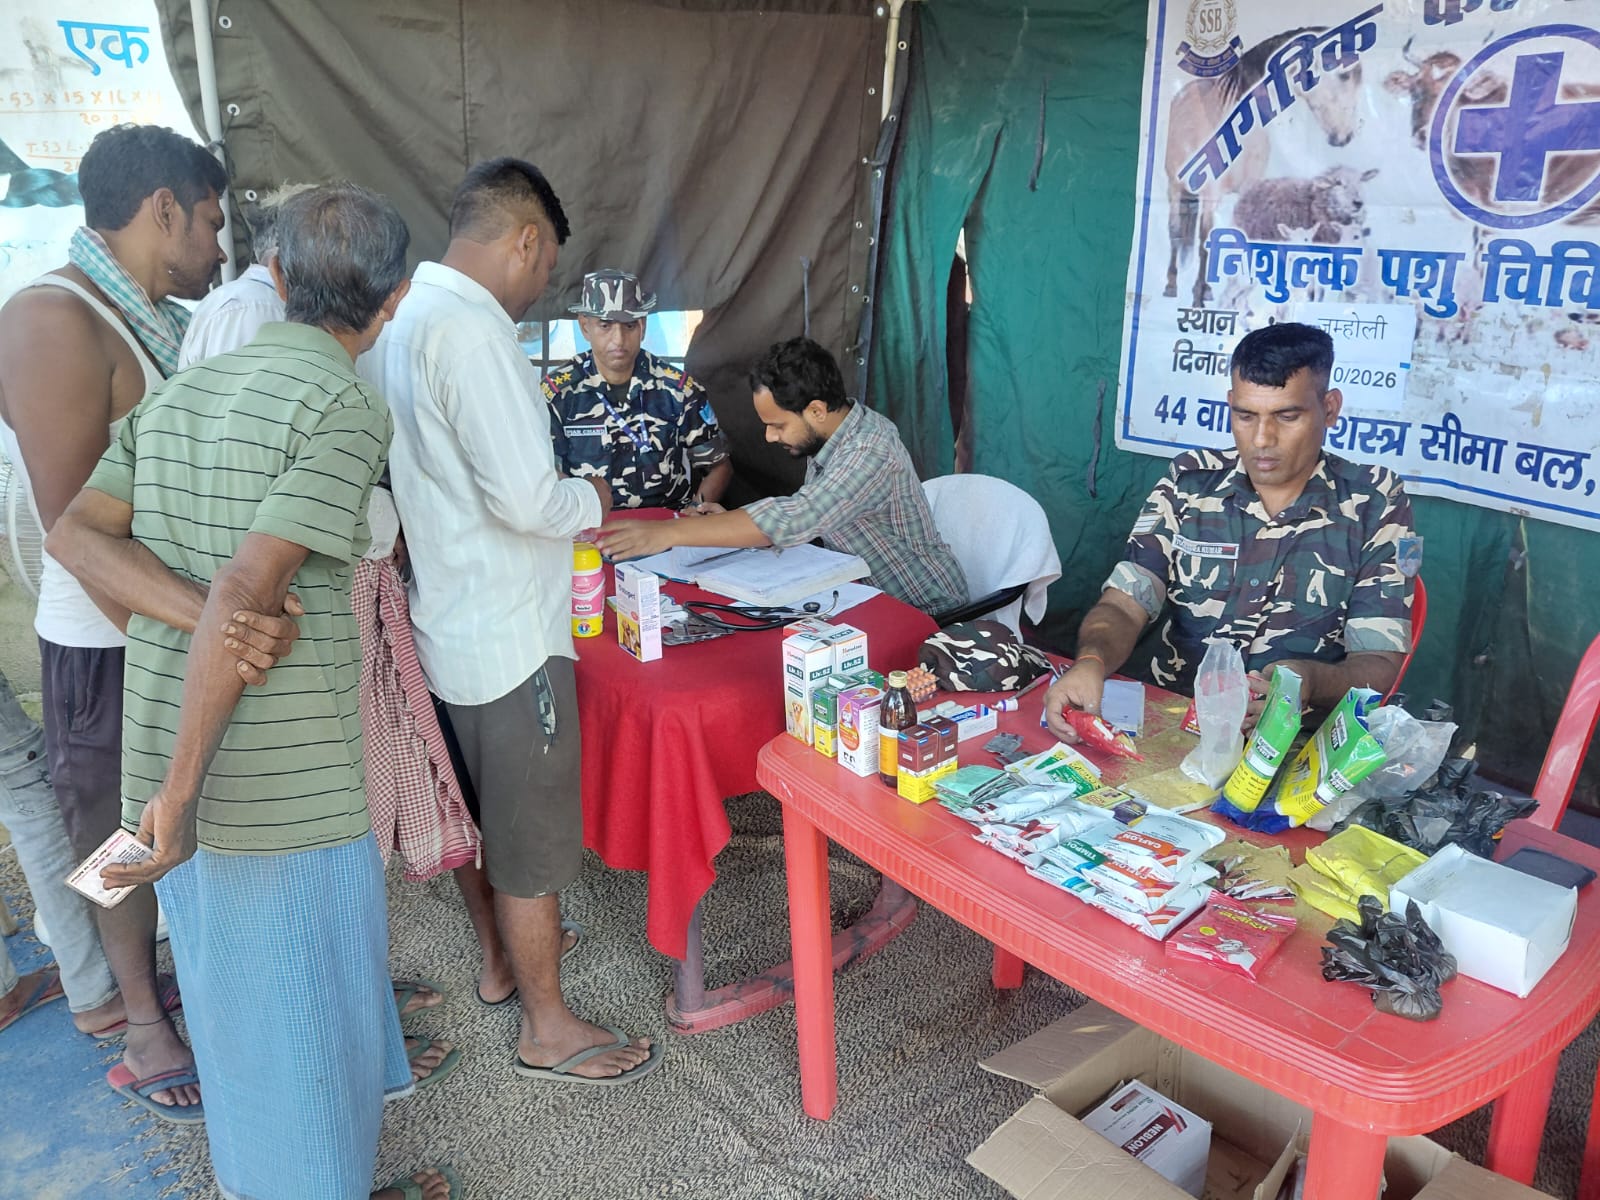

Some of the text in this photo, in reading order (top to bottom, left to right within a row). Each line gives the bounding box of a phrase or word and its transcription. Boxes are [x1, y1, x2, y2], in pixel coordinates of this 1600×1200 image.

[1200, 8, 1222, 33] SSB
[57, 20, 150, 76] एक
[1178, 3, 1383, 192] नागरिक
[1206, 228, 1363, 303] निशुल्क
[1377, 249, 1466, 319] पशु
[1177, 307, 1239, 336] स्थान
[1154, 395, 1187, 425] 44
[1322, 415, 1411, 456] शस्त्र
[1419, 412, 1508, 474] सीमा
[1515, 442, 1597, 496] बल,
[1122, 833, 1162, 849] CAFLON
[1127, 1124, 1164, 1153] NEBLON
